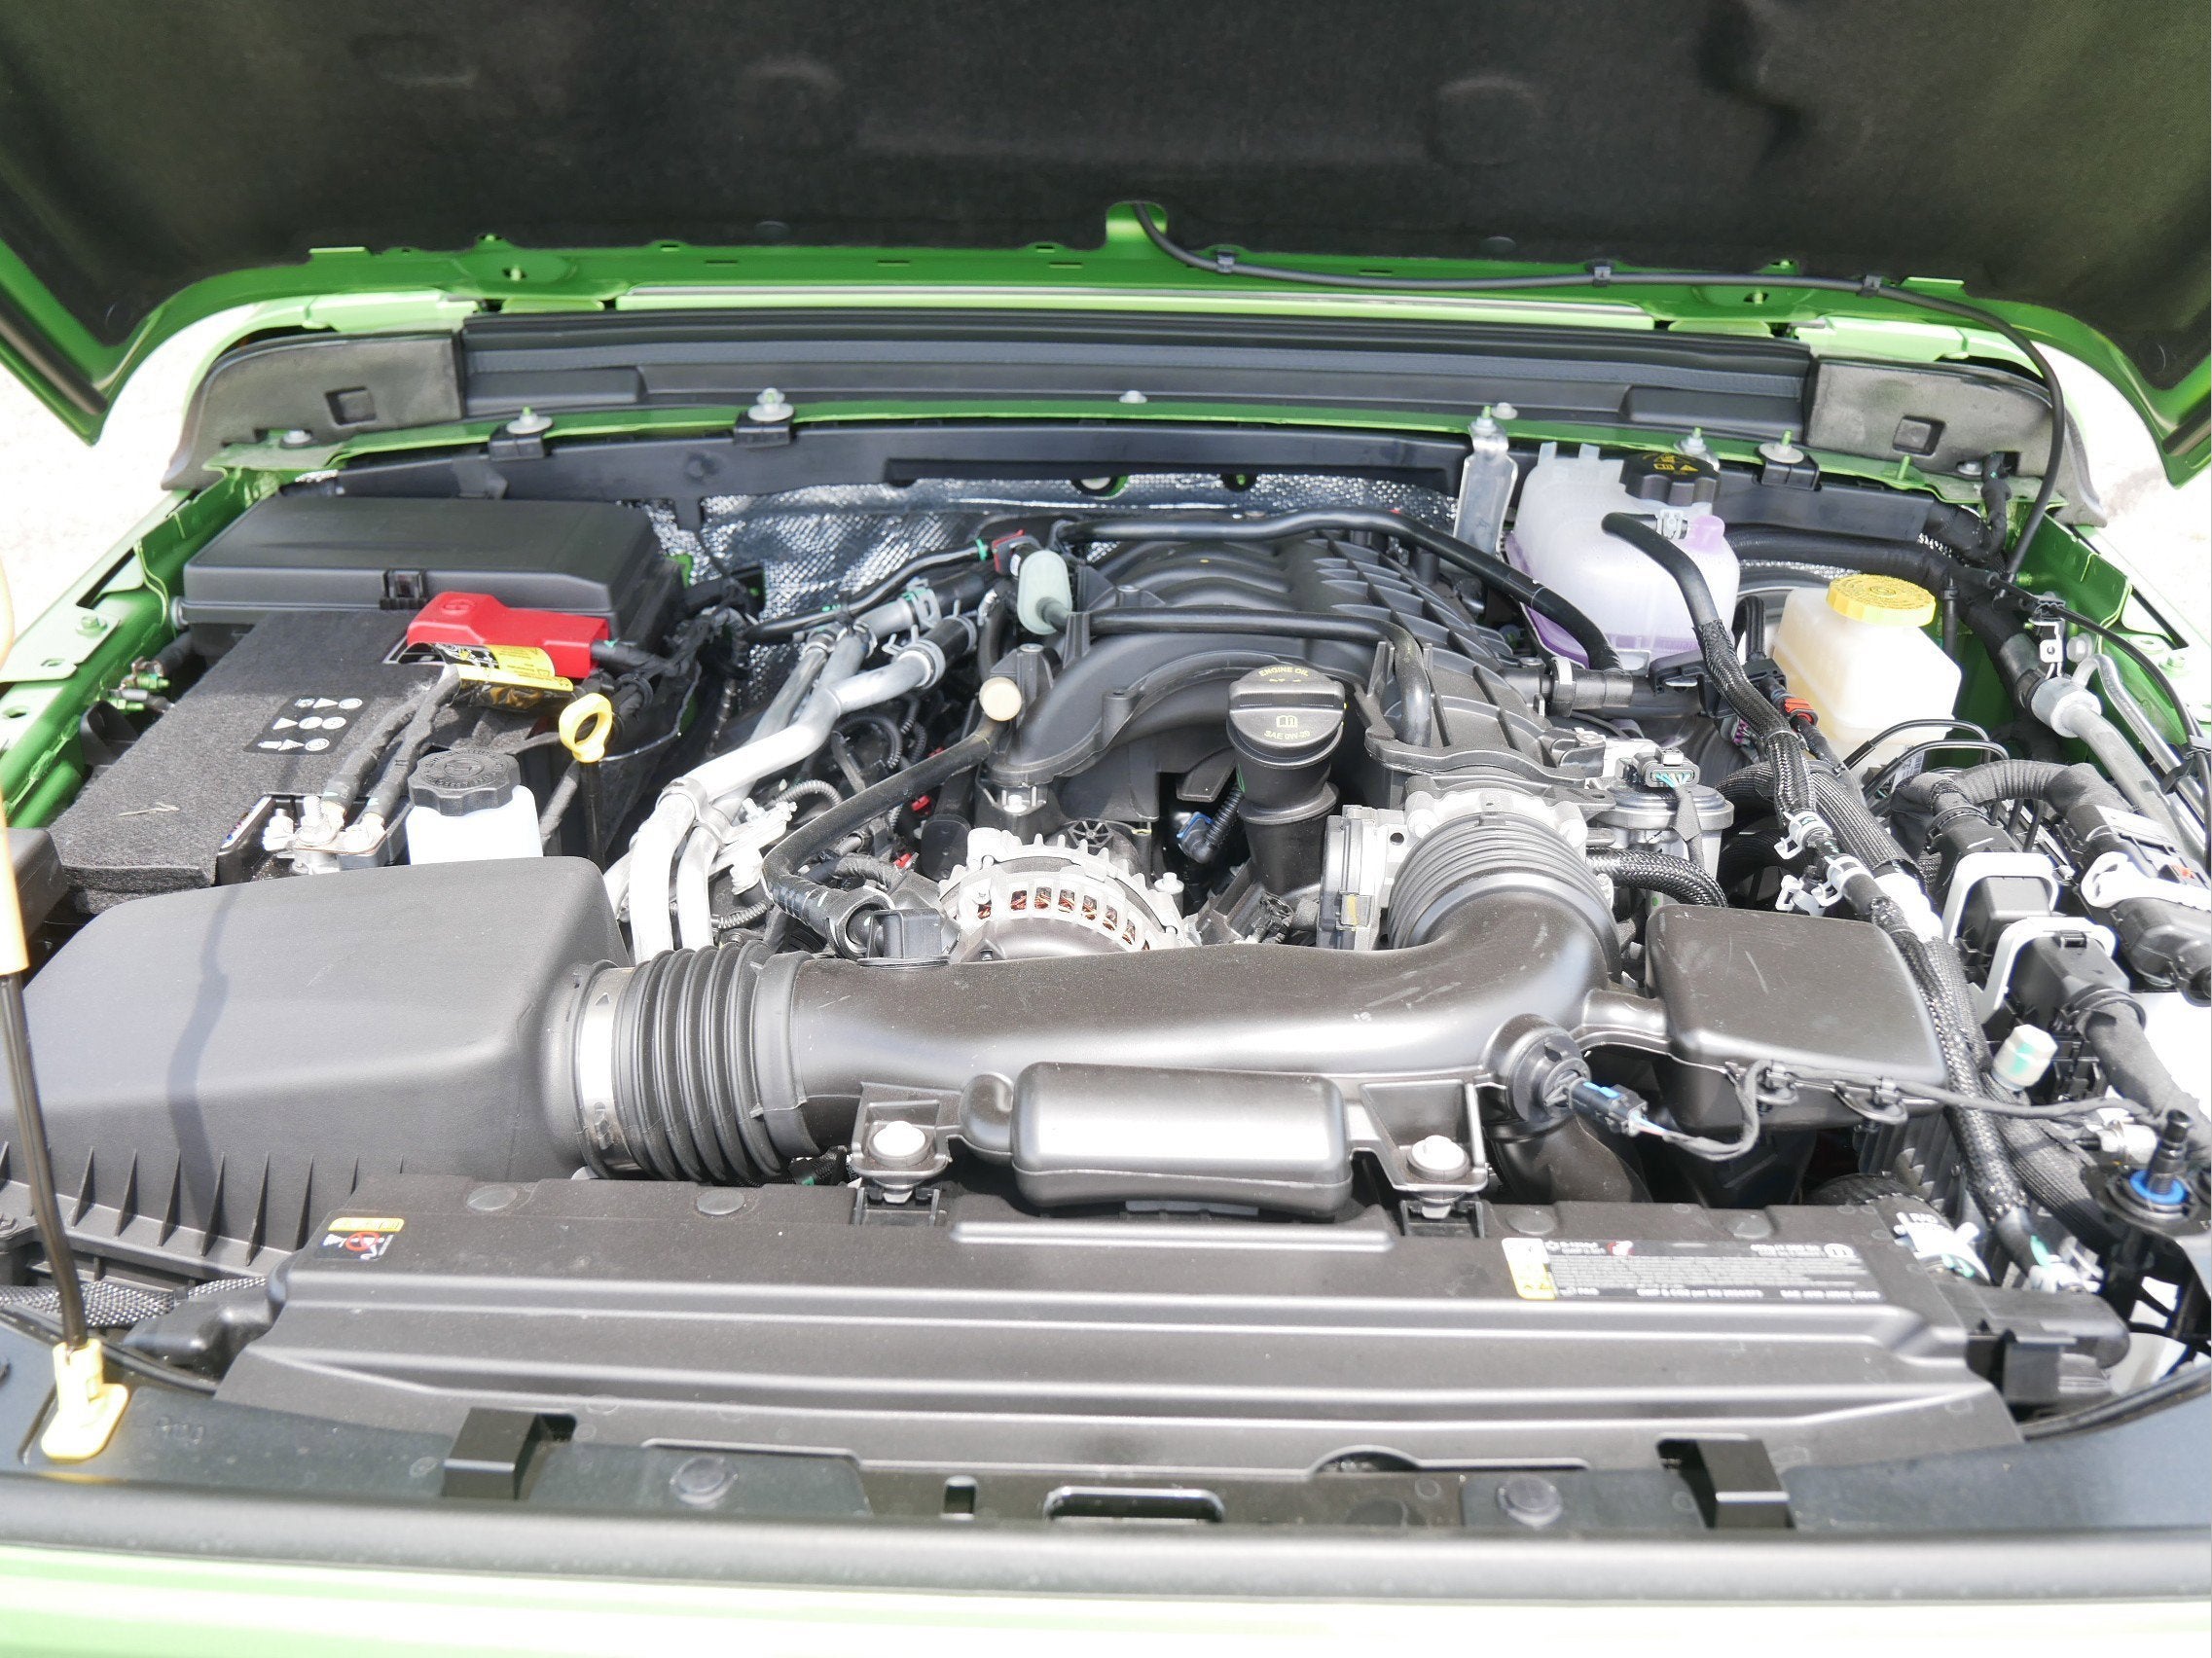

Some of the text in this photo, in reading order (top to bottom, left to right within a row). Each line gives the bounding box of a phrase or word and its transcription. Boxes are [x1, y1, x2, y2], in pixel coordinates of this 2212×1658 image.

[1258, 667, 1309, 676] ENGINE OIL
[1264, 730, 1284, 739] SAE
